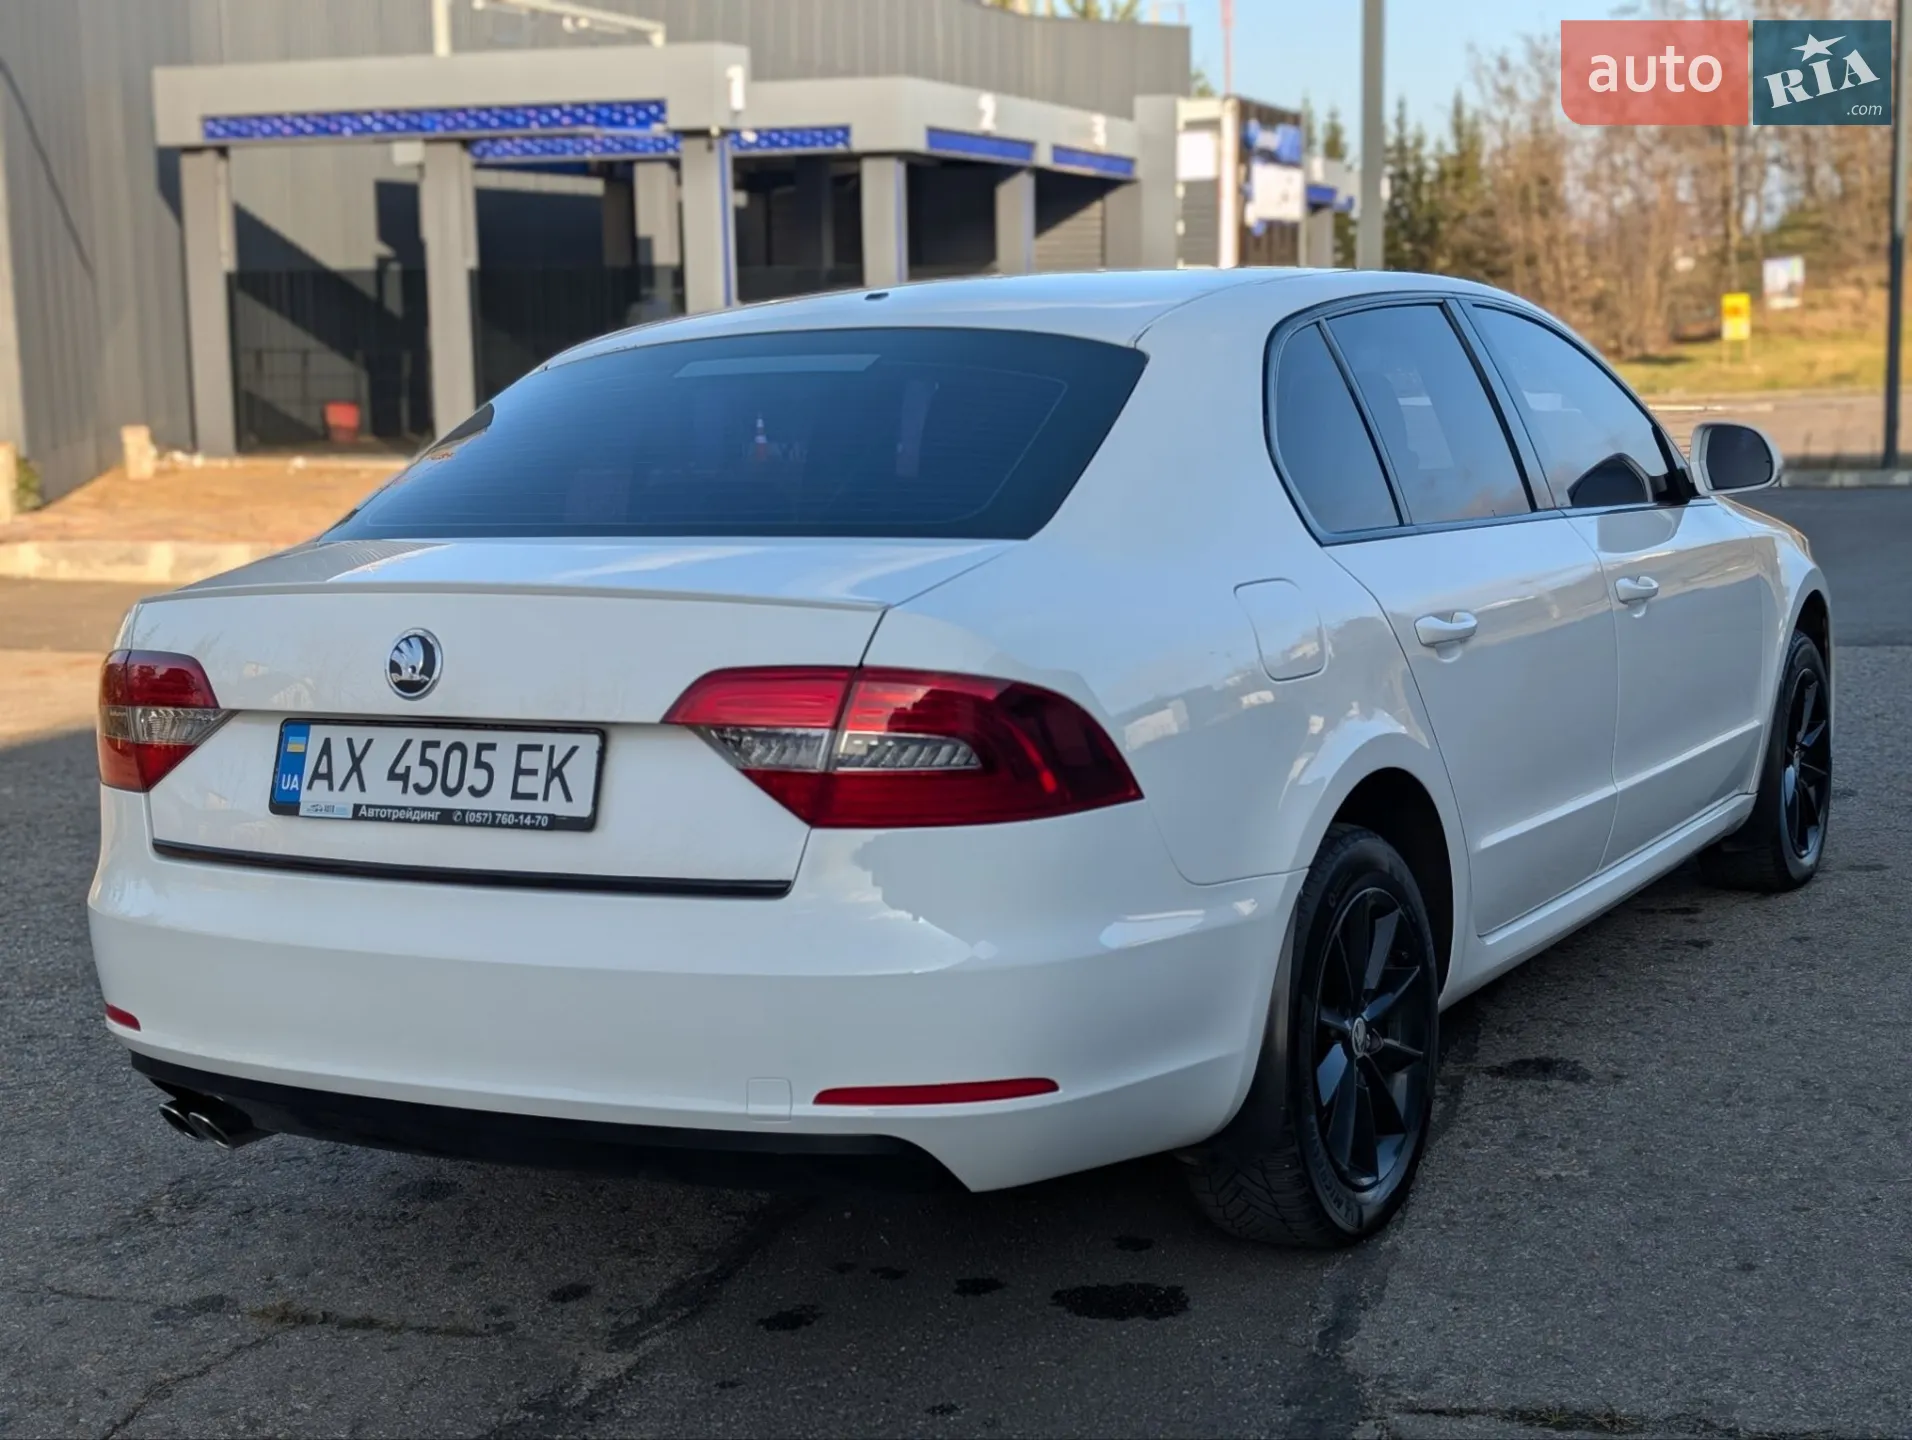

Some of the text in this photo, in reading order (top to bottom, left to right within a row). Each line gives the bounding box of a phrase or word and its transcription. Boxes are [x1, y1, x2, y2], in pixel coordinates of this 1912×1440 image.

[306, 737, 580, 803] AX 4505 EK
[281, 773, 299, 791] UA
[358, 805, 549, 827] Автотрейдинг (057) 760-14-70
